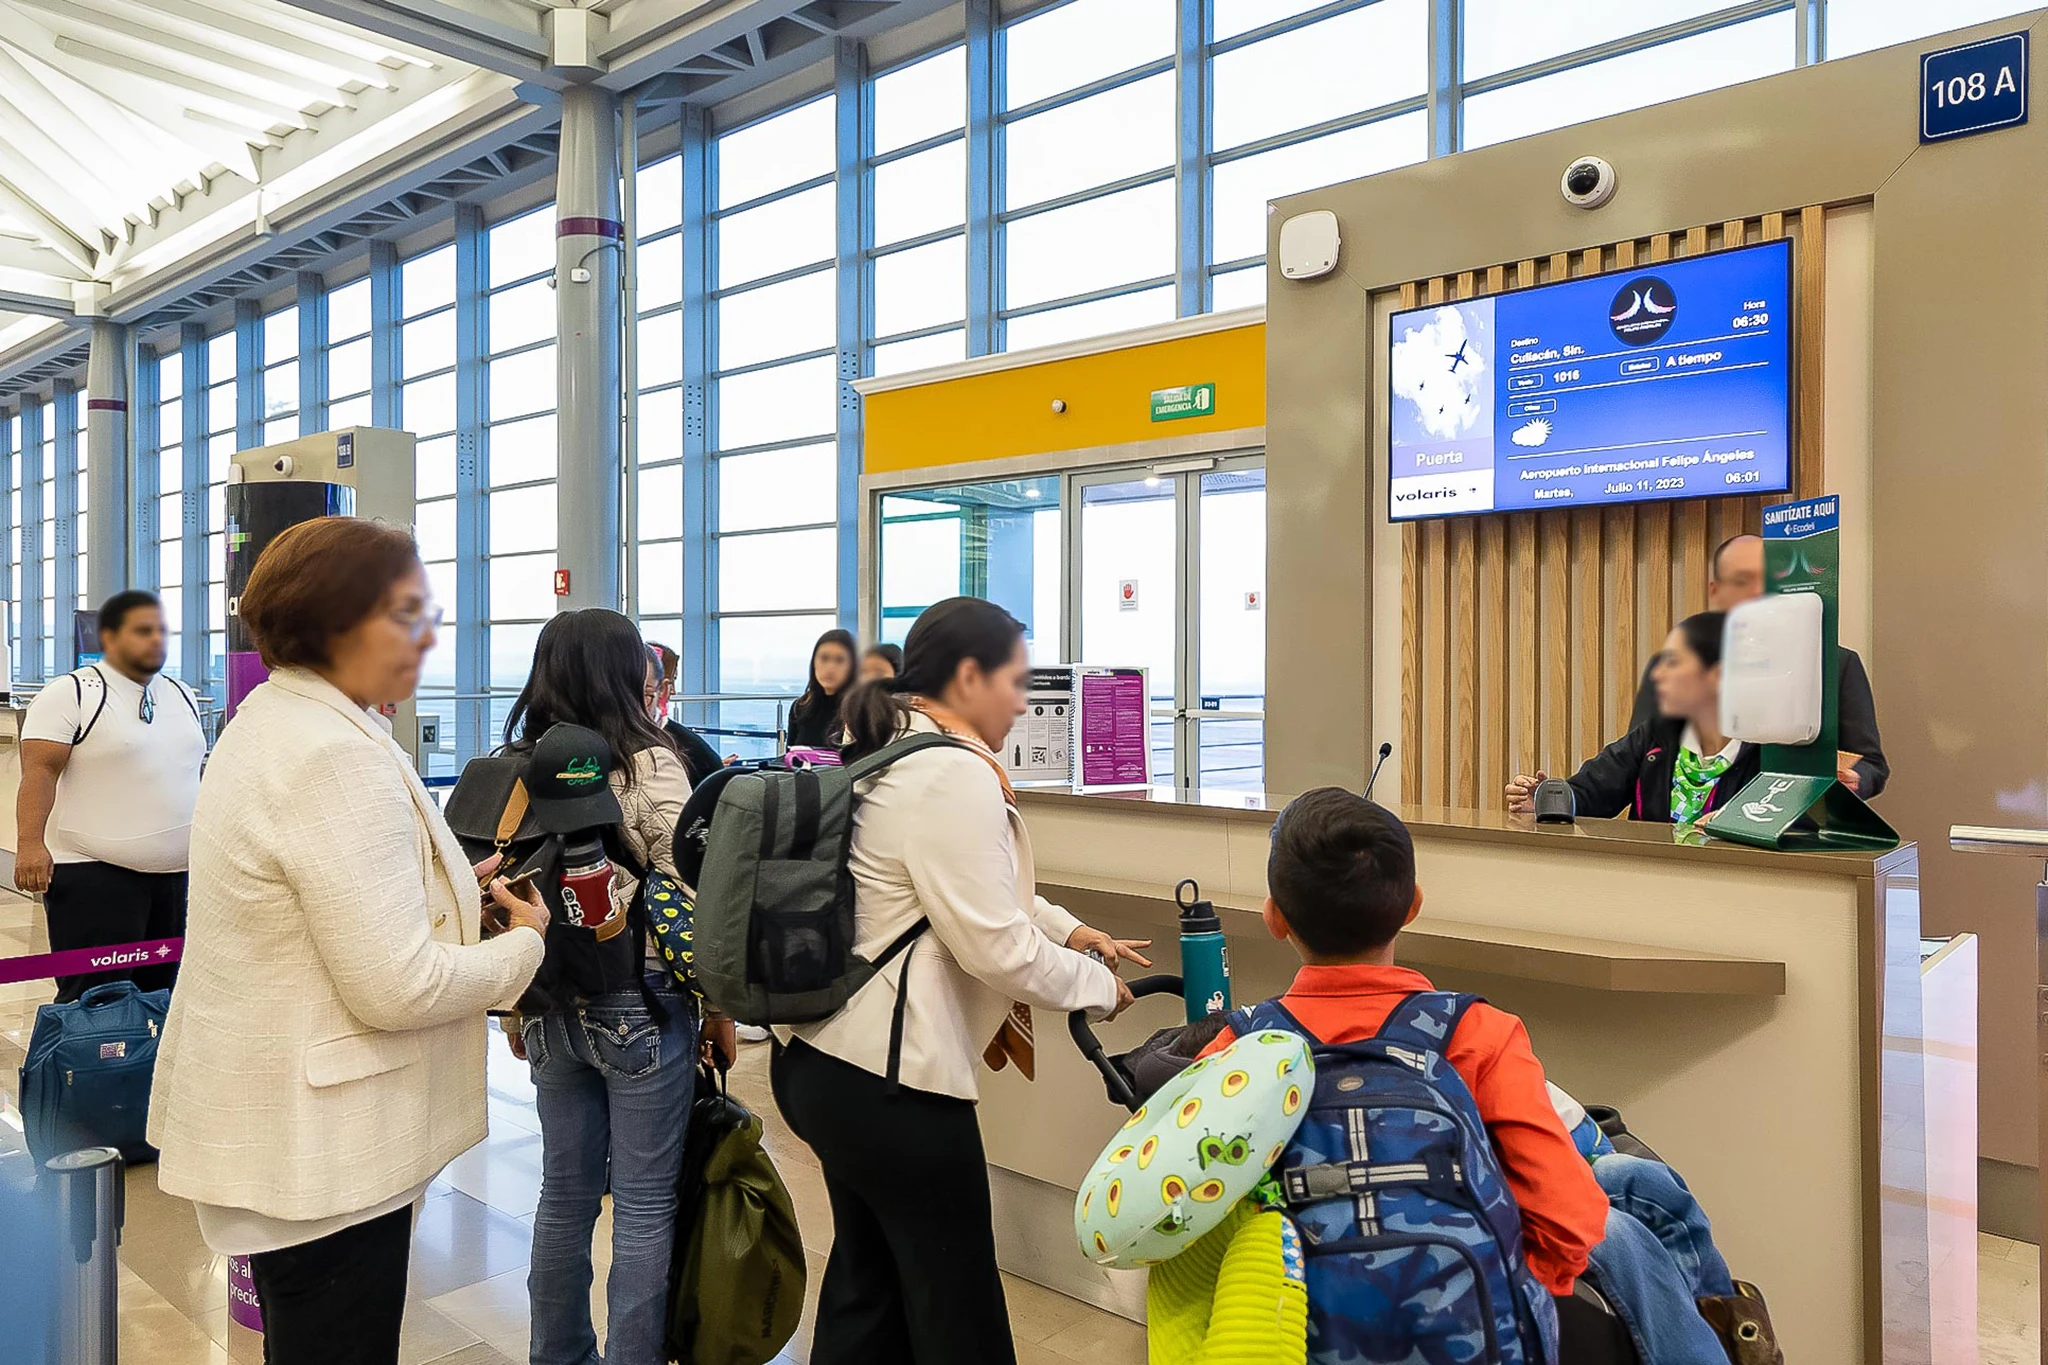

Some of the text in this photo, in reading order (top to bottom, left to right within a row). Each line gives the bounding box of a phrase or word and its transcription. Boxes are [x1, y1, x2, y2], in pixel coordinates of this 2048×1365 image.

[1932, 65, 2016, 108] 108 A
[1743, 300, 1766, 311] Hora
[1732, 313, 1769, 328] 06:30
[1510, 337, 1539, 348] Destino
[1562, 344, 1586, 357] Sin.
[1665, 355, 1677, 368] A
[1678, 351, 1722, 367] tiempo
[1415, 450, 1463, 467] Puerta
[1519, 449, 1755, 481] Aeropuerto Internacional Felipe Ángeles
[1725, 471, 1760, 484] 06:01
[1604, 477, 1685, 494] Julio 11, 2023
[1396, 487, 1457, 502] volaris
[1534, 488, 1574, 500] Martes,
[1764, 497, 1836, 525] SANITÍZATE AQUÍ
[1792, 521, 1816, 534] Ecodeli
[90, 948, 149, 967] volaris
